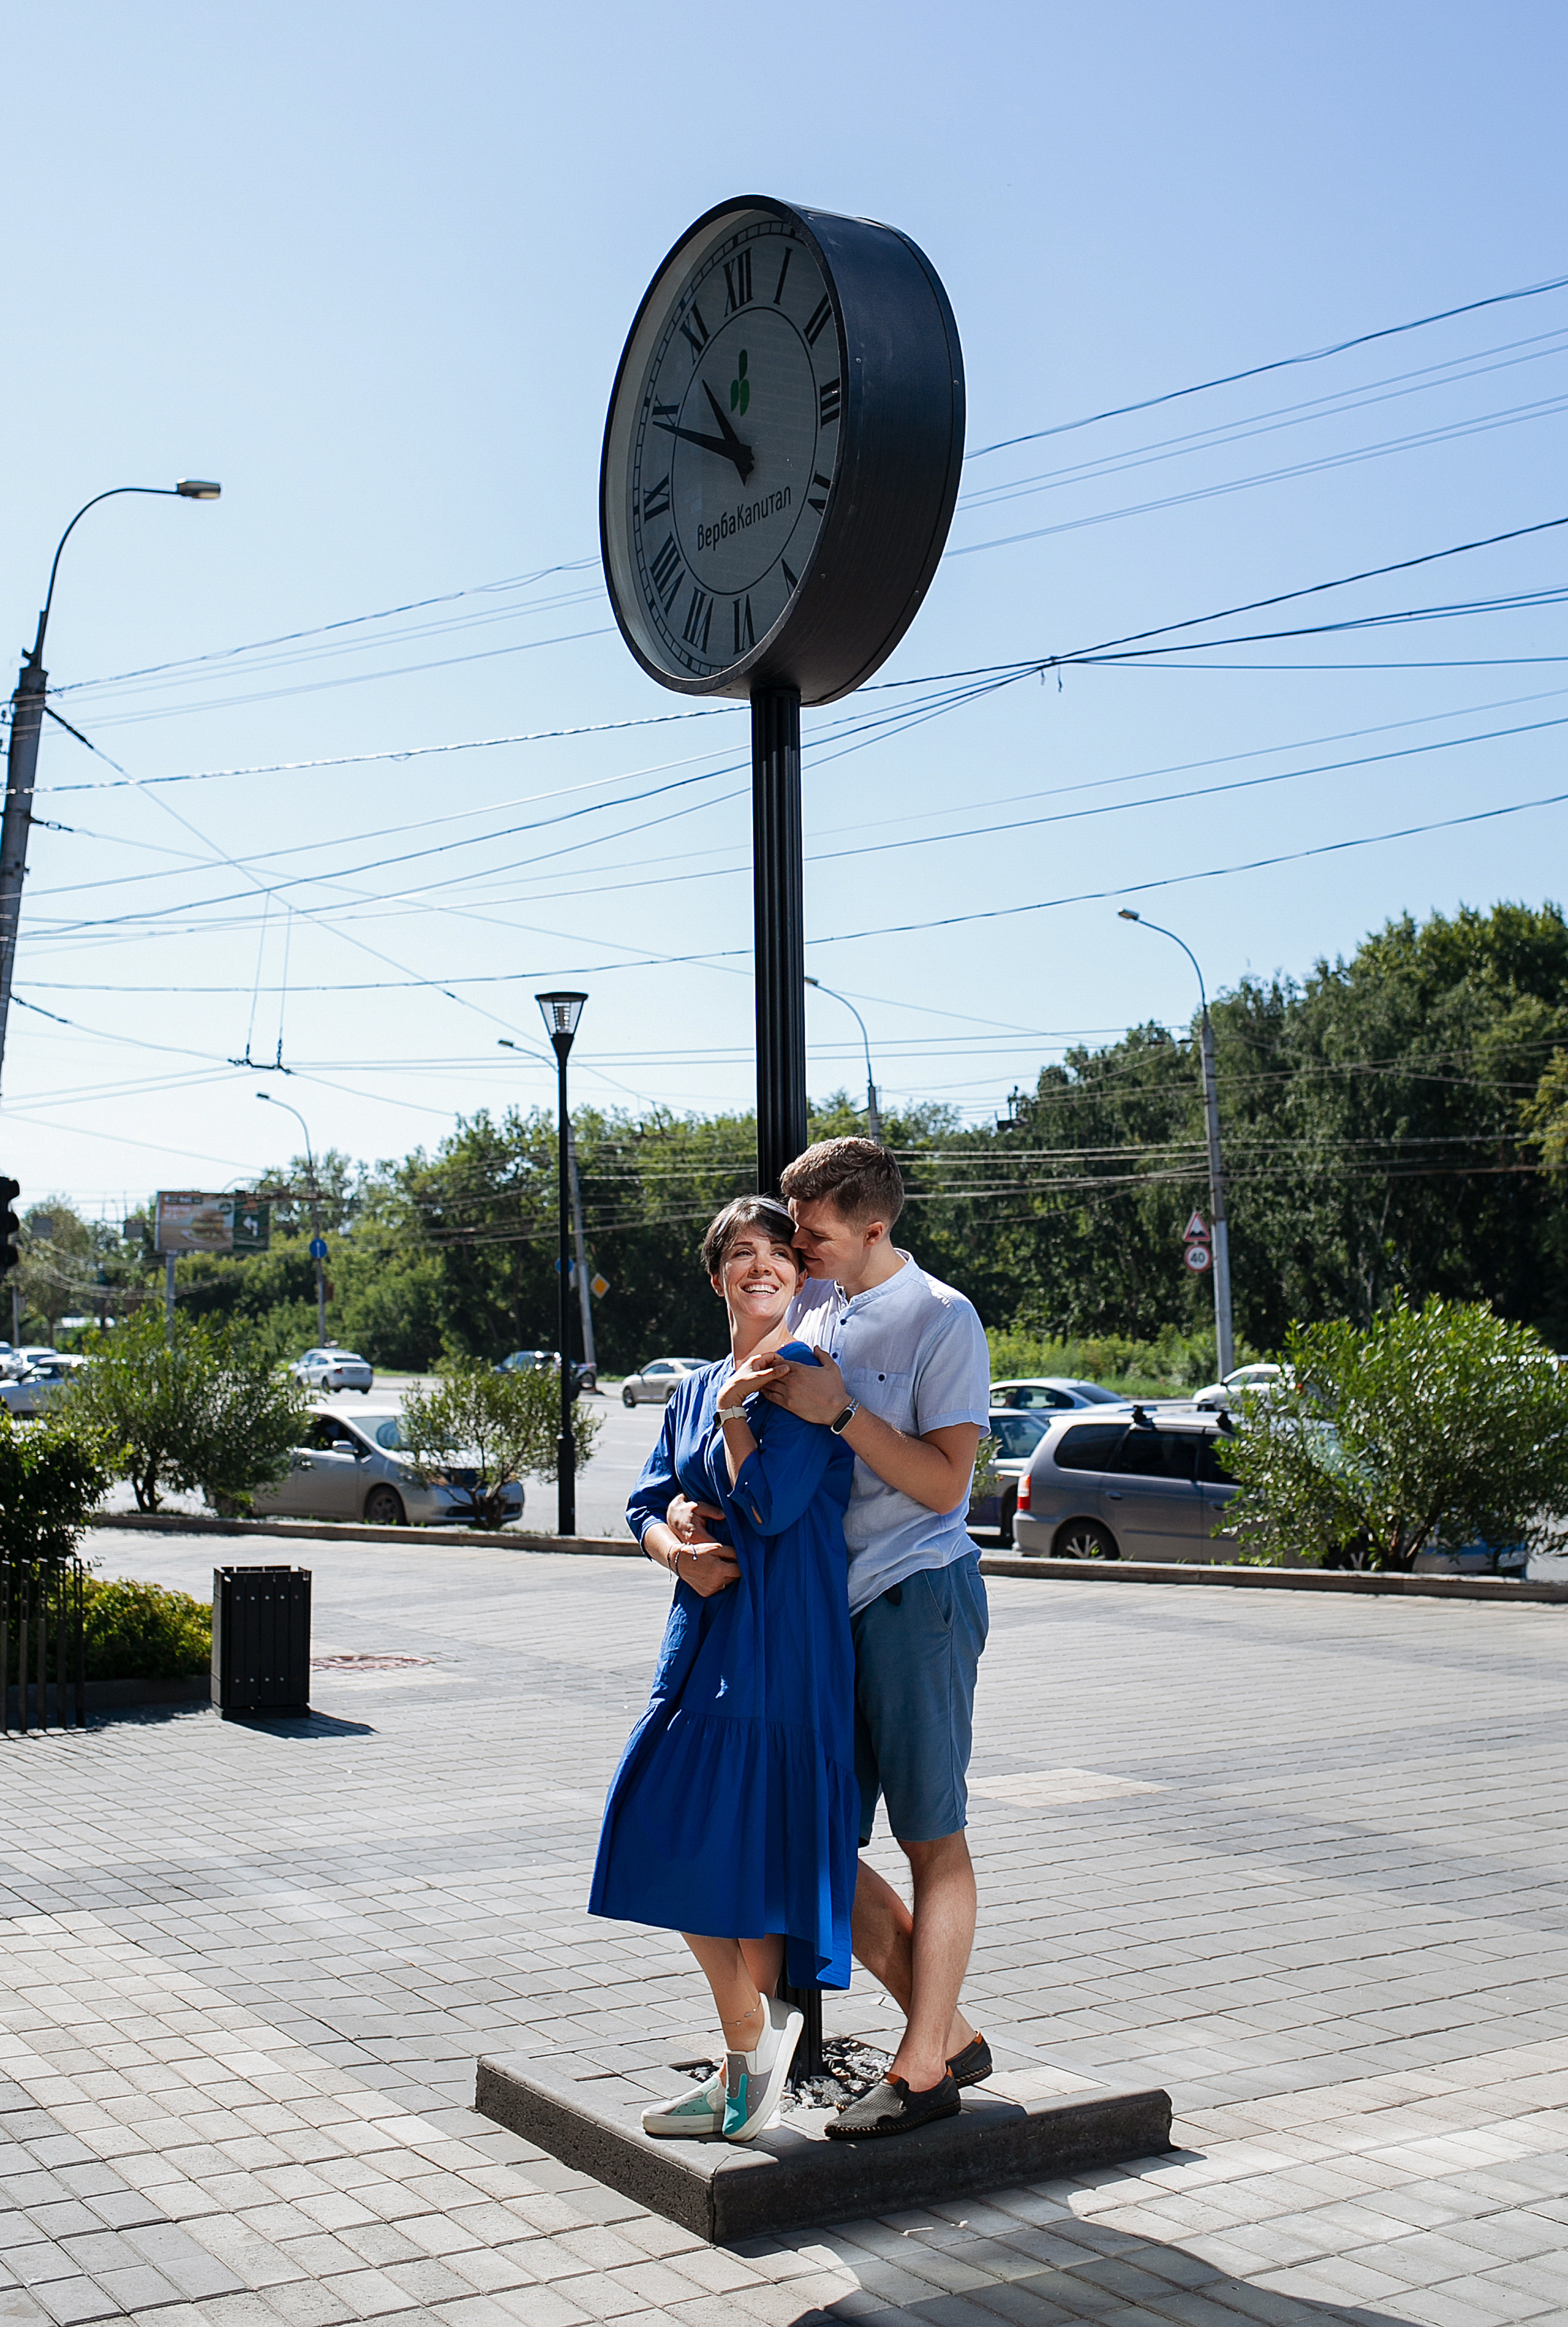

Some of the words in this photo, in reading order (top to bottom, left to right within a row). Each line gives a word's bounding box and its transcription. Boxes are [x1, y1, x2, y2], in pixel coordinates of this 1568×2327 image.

[723, 247, 753, 317] XII
[679, 300, 710, 366] XI
[803, 292, 834, 349] II
[652, 394, 680, 426] X
[820, 377, 840, 429] III
[643, 472, 670, 524] IX
[697, 486, 791, 551] ВербаКапитал
[650, 531, 686, 618] VIII
[682, 586, 714, 654] VII
[733, 594, 758, 655] VI
[1191, 1253, 1205, 1263] 40
